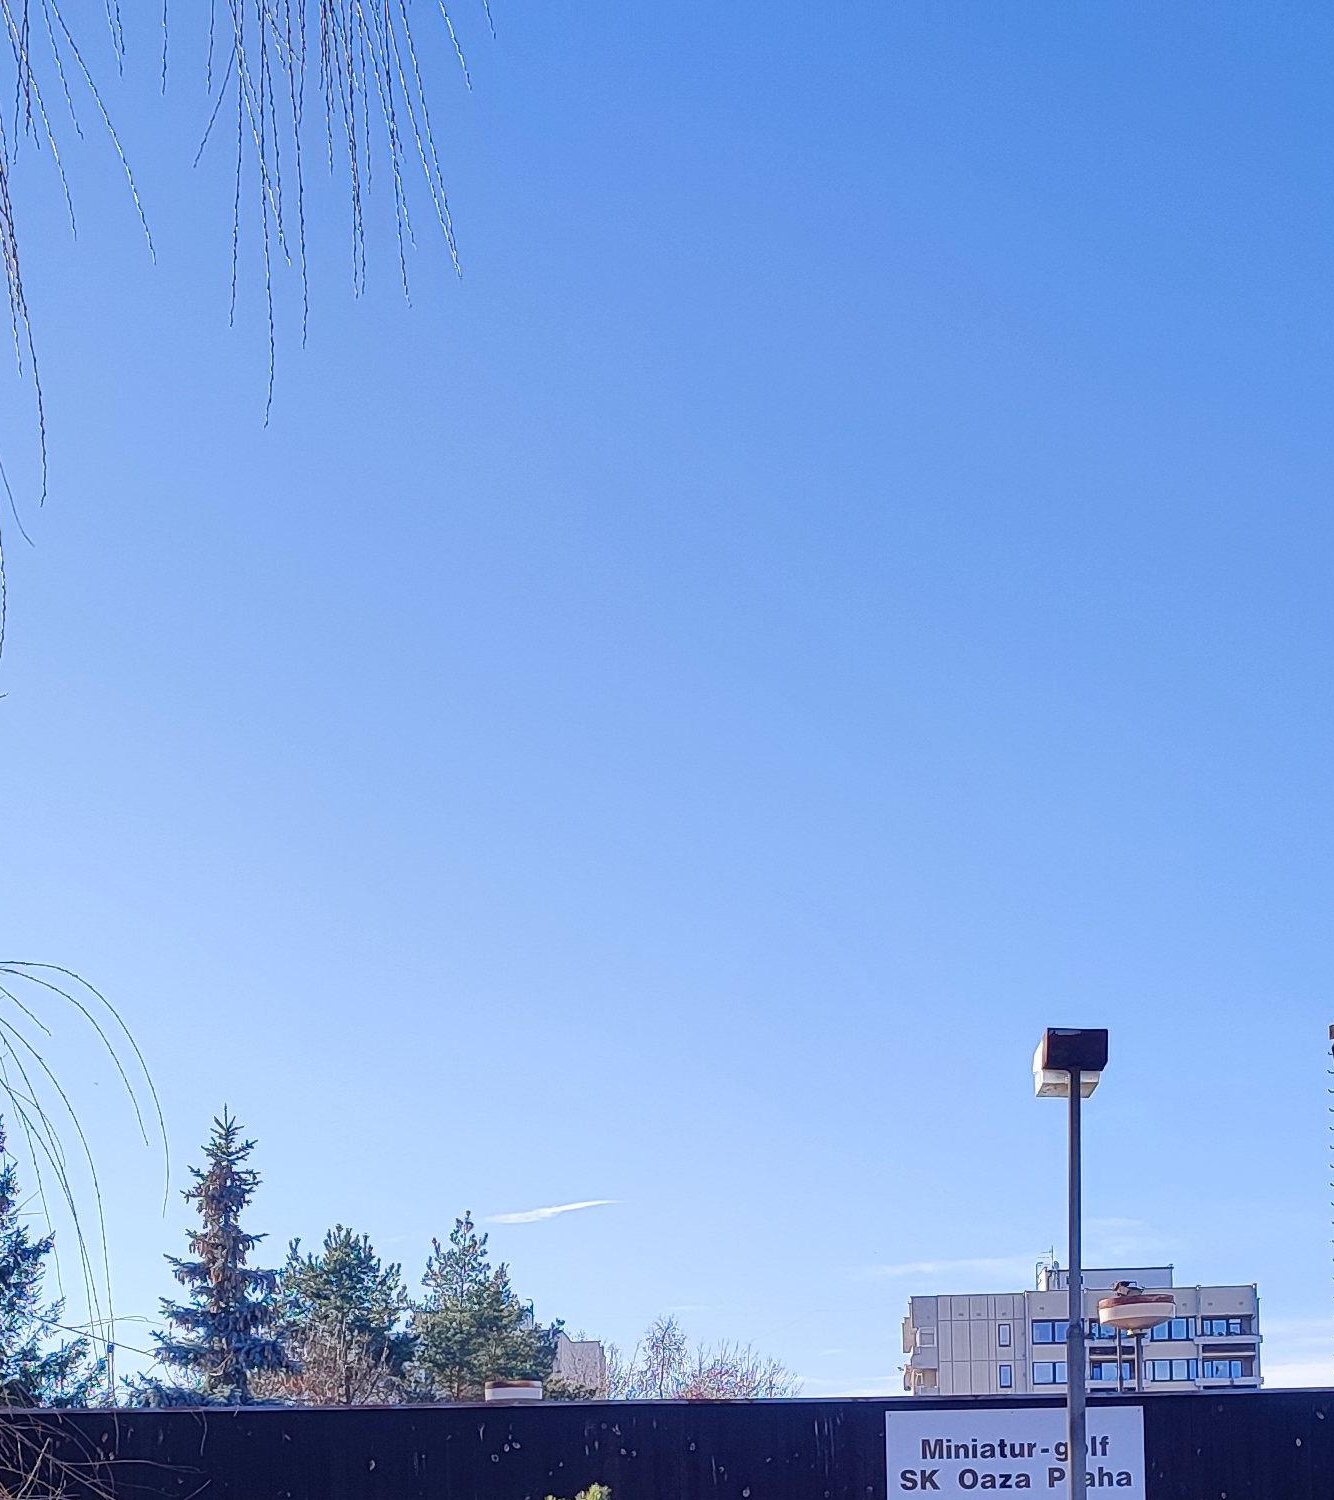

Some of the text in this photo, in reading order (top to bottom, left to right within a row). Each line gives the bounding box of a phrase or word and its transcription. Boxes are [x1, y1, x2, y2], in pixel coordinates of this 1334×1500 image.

[921, 1436, 1109, 1462] Miniatur-glf
[900, 1466, 1132, 1491] SK Oaza Paha
